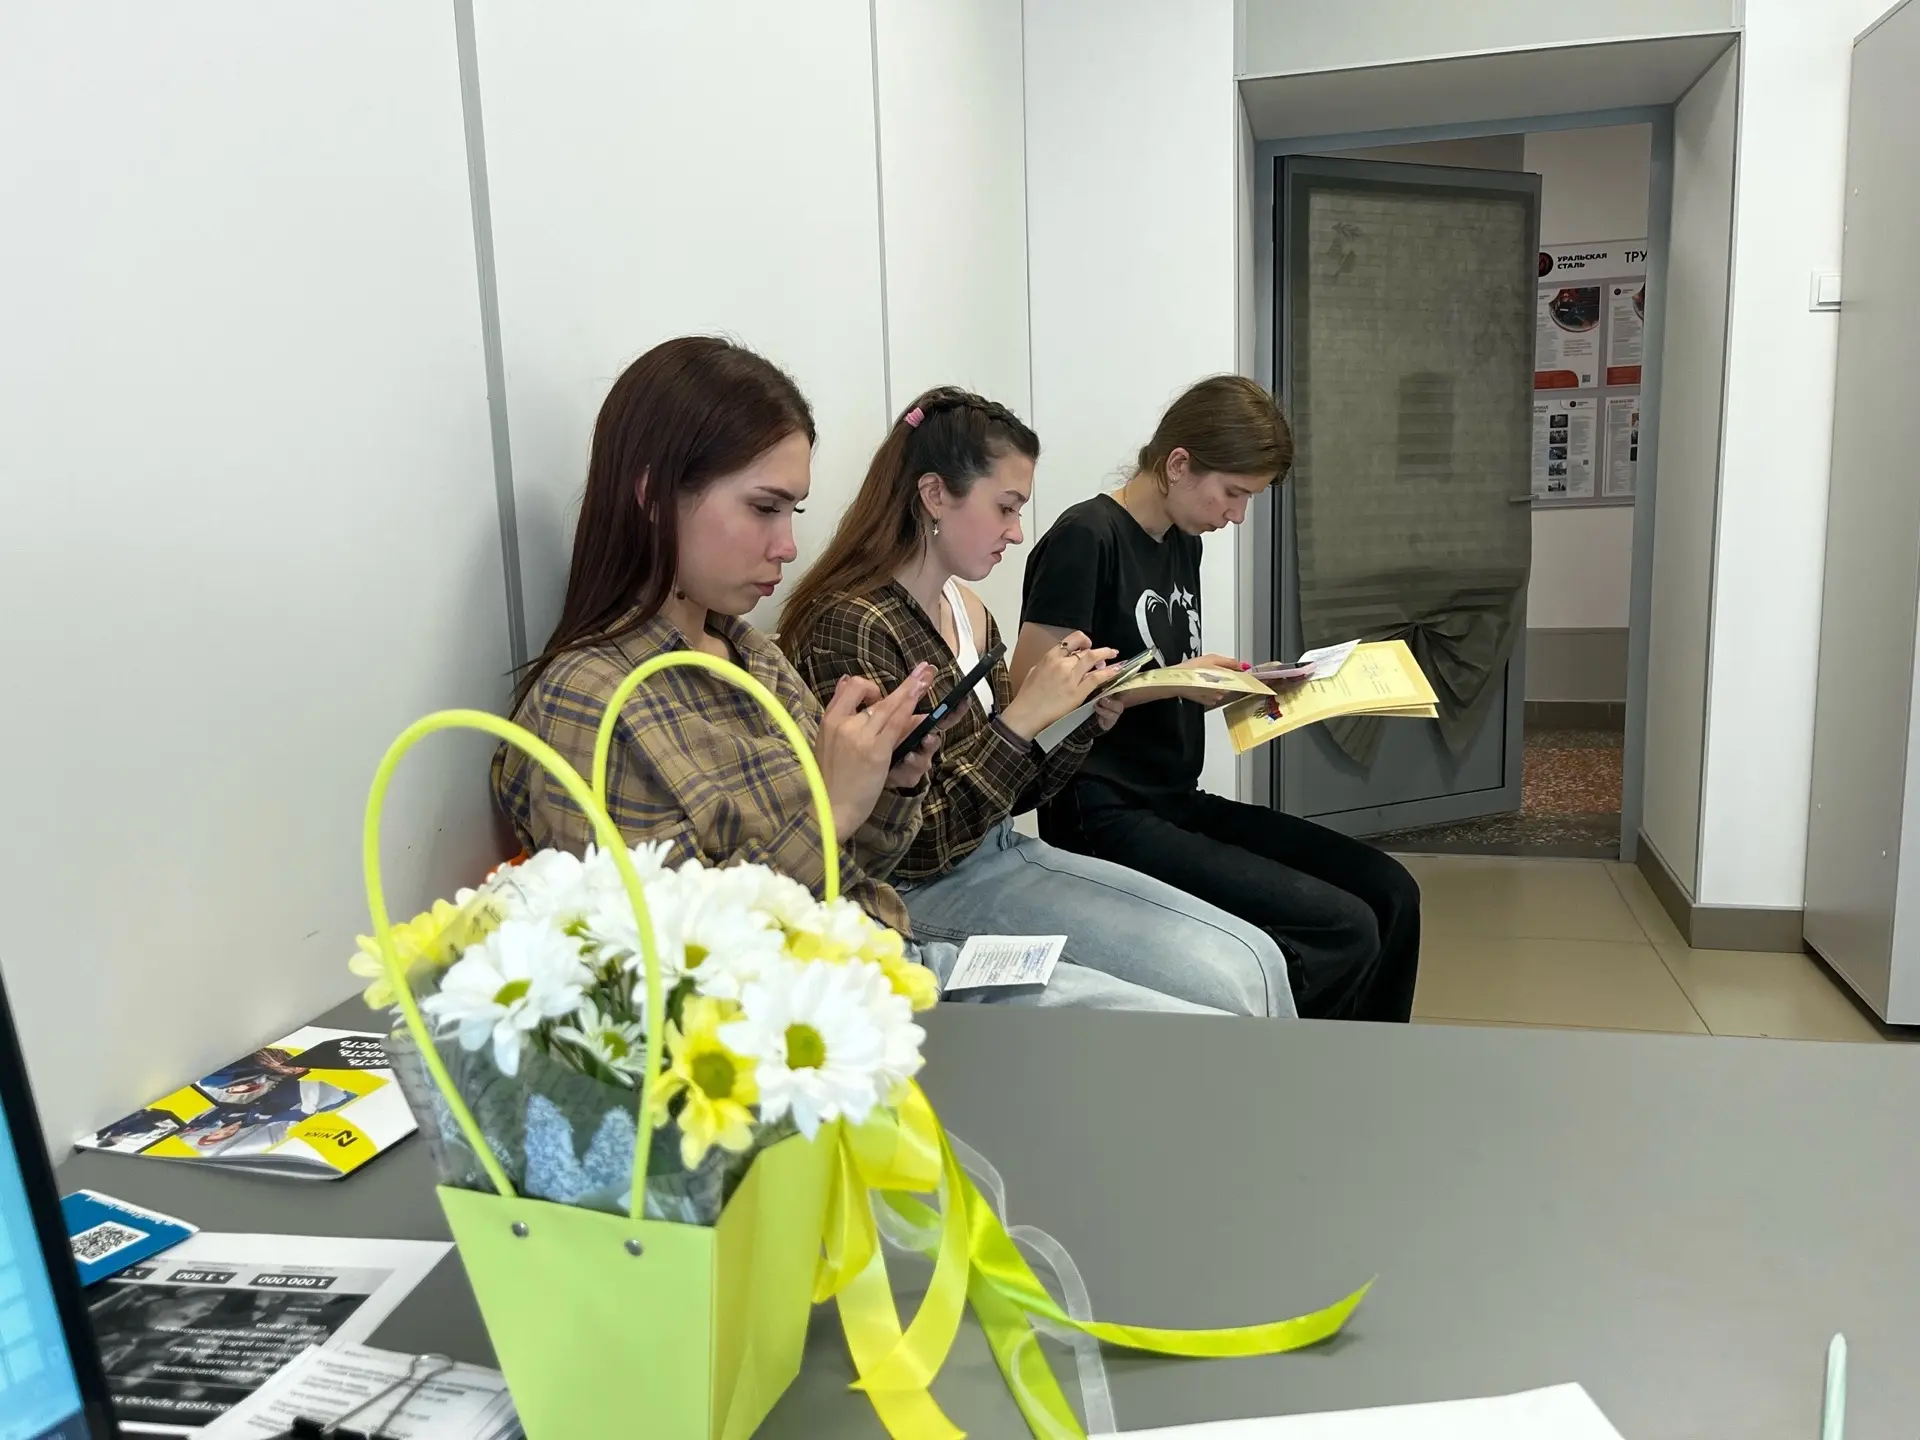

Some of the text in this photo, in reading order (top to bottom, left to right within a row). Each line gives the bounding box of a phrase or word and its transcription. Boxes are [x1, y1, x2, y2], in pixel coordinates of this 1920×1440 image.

[1557, 252, 1607, 262] УРАЛЬСКАЯ
[1624, 250, 1647, 263] ТРУ
[340, 1040, 382, 1049] ОСТЬ
[348, 1058, 389, 1066] ОСТЬ,
[175, 1400, 232, 1412] острой
